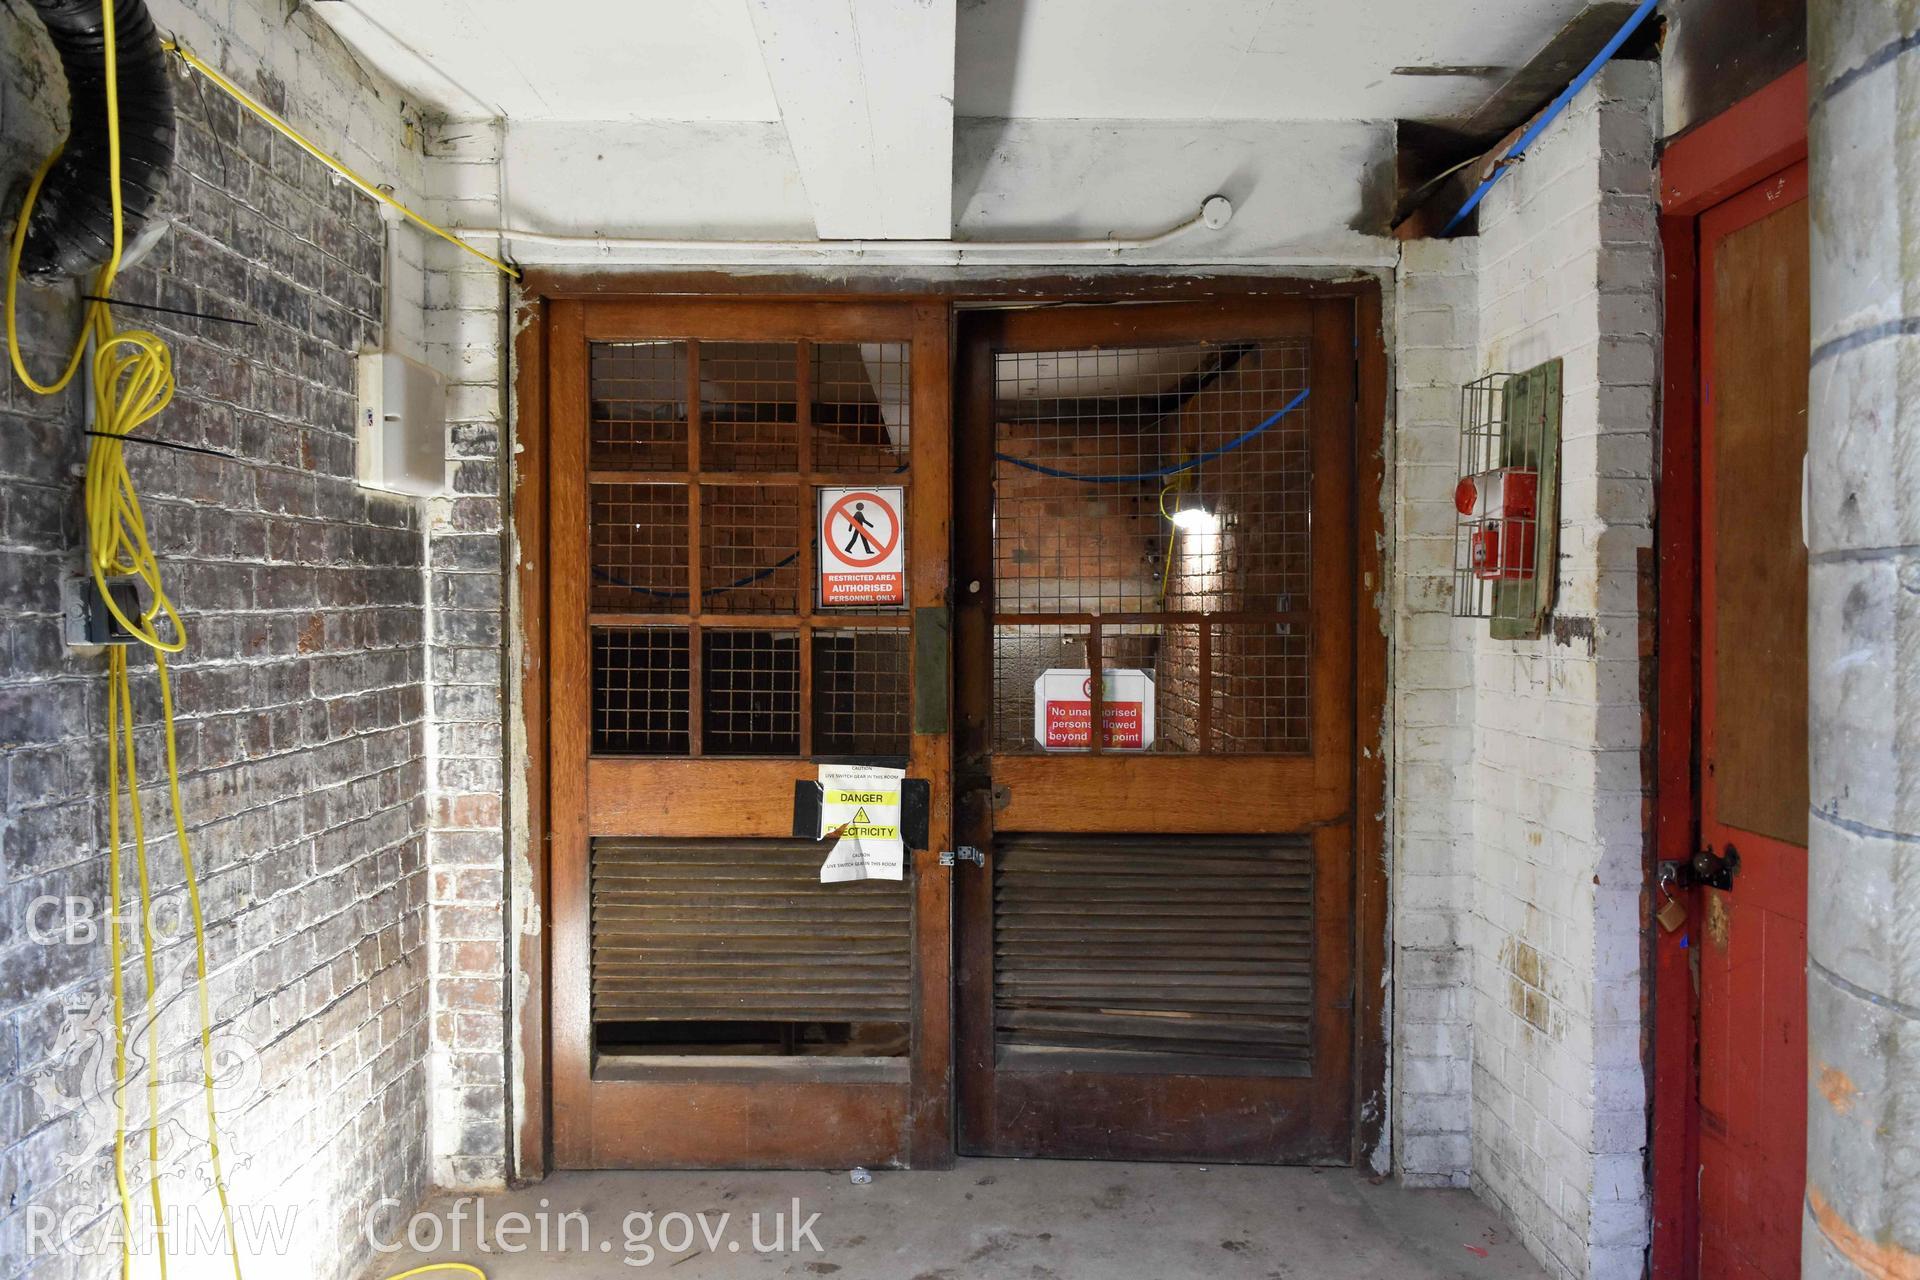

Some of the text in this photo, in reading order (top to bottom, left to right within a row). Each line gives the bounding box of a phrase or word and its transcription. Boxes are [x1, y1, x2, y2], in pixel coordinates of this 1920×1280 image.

[832, 584, 893, 593] AUTHORISED
[1051, 707, 1066, 716] No
[1102, 720, 1137, 729] llowed
[1049, 731, 1088, 743] beyond
[1112, 733, 1139, 742] point
[840, 793, 883, 803] DANGER
